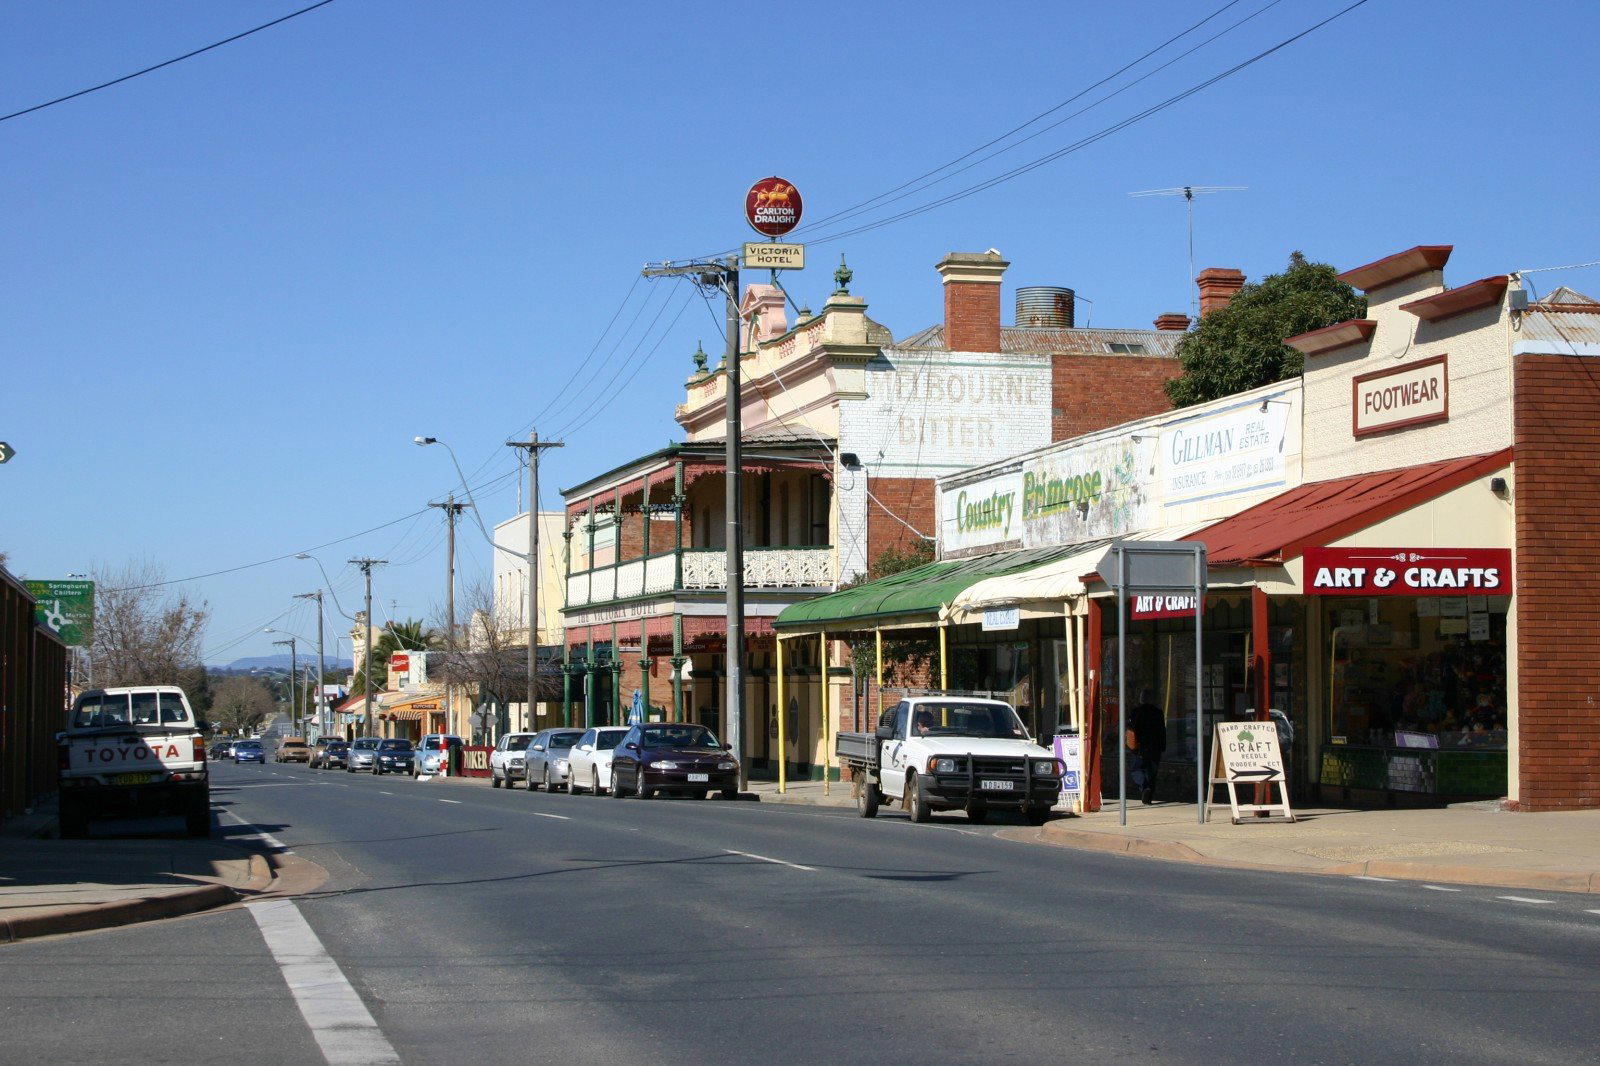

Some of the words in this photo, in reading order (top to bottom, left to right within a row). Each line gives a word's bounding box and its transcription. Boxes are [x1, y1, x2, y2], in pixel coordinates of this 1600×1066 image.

[754, 214, 795, 223] DRAUGHT
[756, 207, 794, 215] CARLTON
[749, 247, 800, 255] VICTORIA
[1365, 377, 1439, 415] FOOTWEAR
[898, 415, 995, 448] BITTER
[1245, 420, 1265, 435] REAL
[1172, 428, 1234, 465] GILLMAN
[1239, 431, 1270, 450] ESTATE
[1022, 470, 1101, 521] Primrose
[957, 489, 1016, 539] Country
[1313, 567, 1366, 588] ART
[1373, 567, 1396, 588] &
[1404, 567, 1499, 588] CRAFTS
[1135, 596, 1153, 612] ART
[1155, 596, 1163, 612] &
[1221, 725, 1239, 733] HAND
[1243, 724, 1275, 733] CRAFTED
[85, 744, 180, 763] TOYOTA
[1229, 742, 1271, 753] CRAFT
